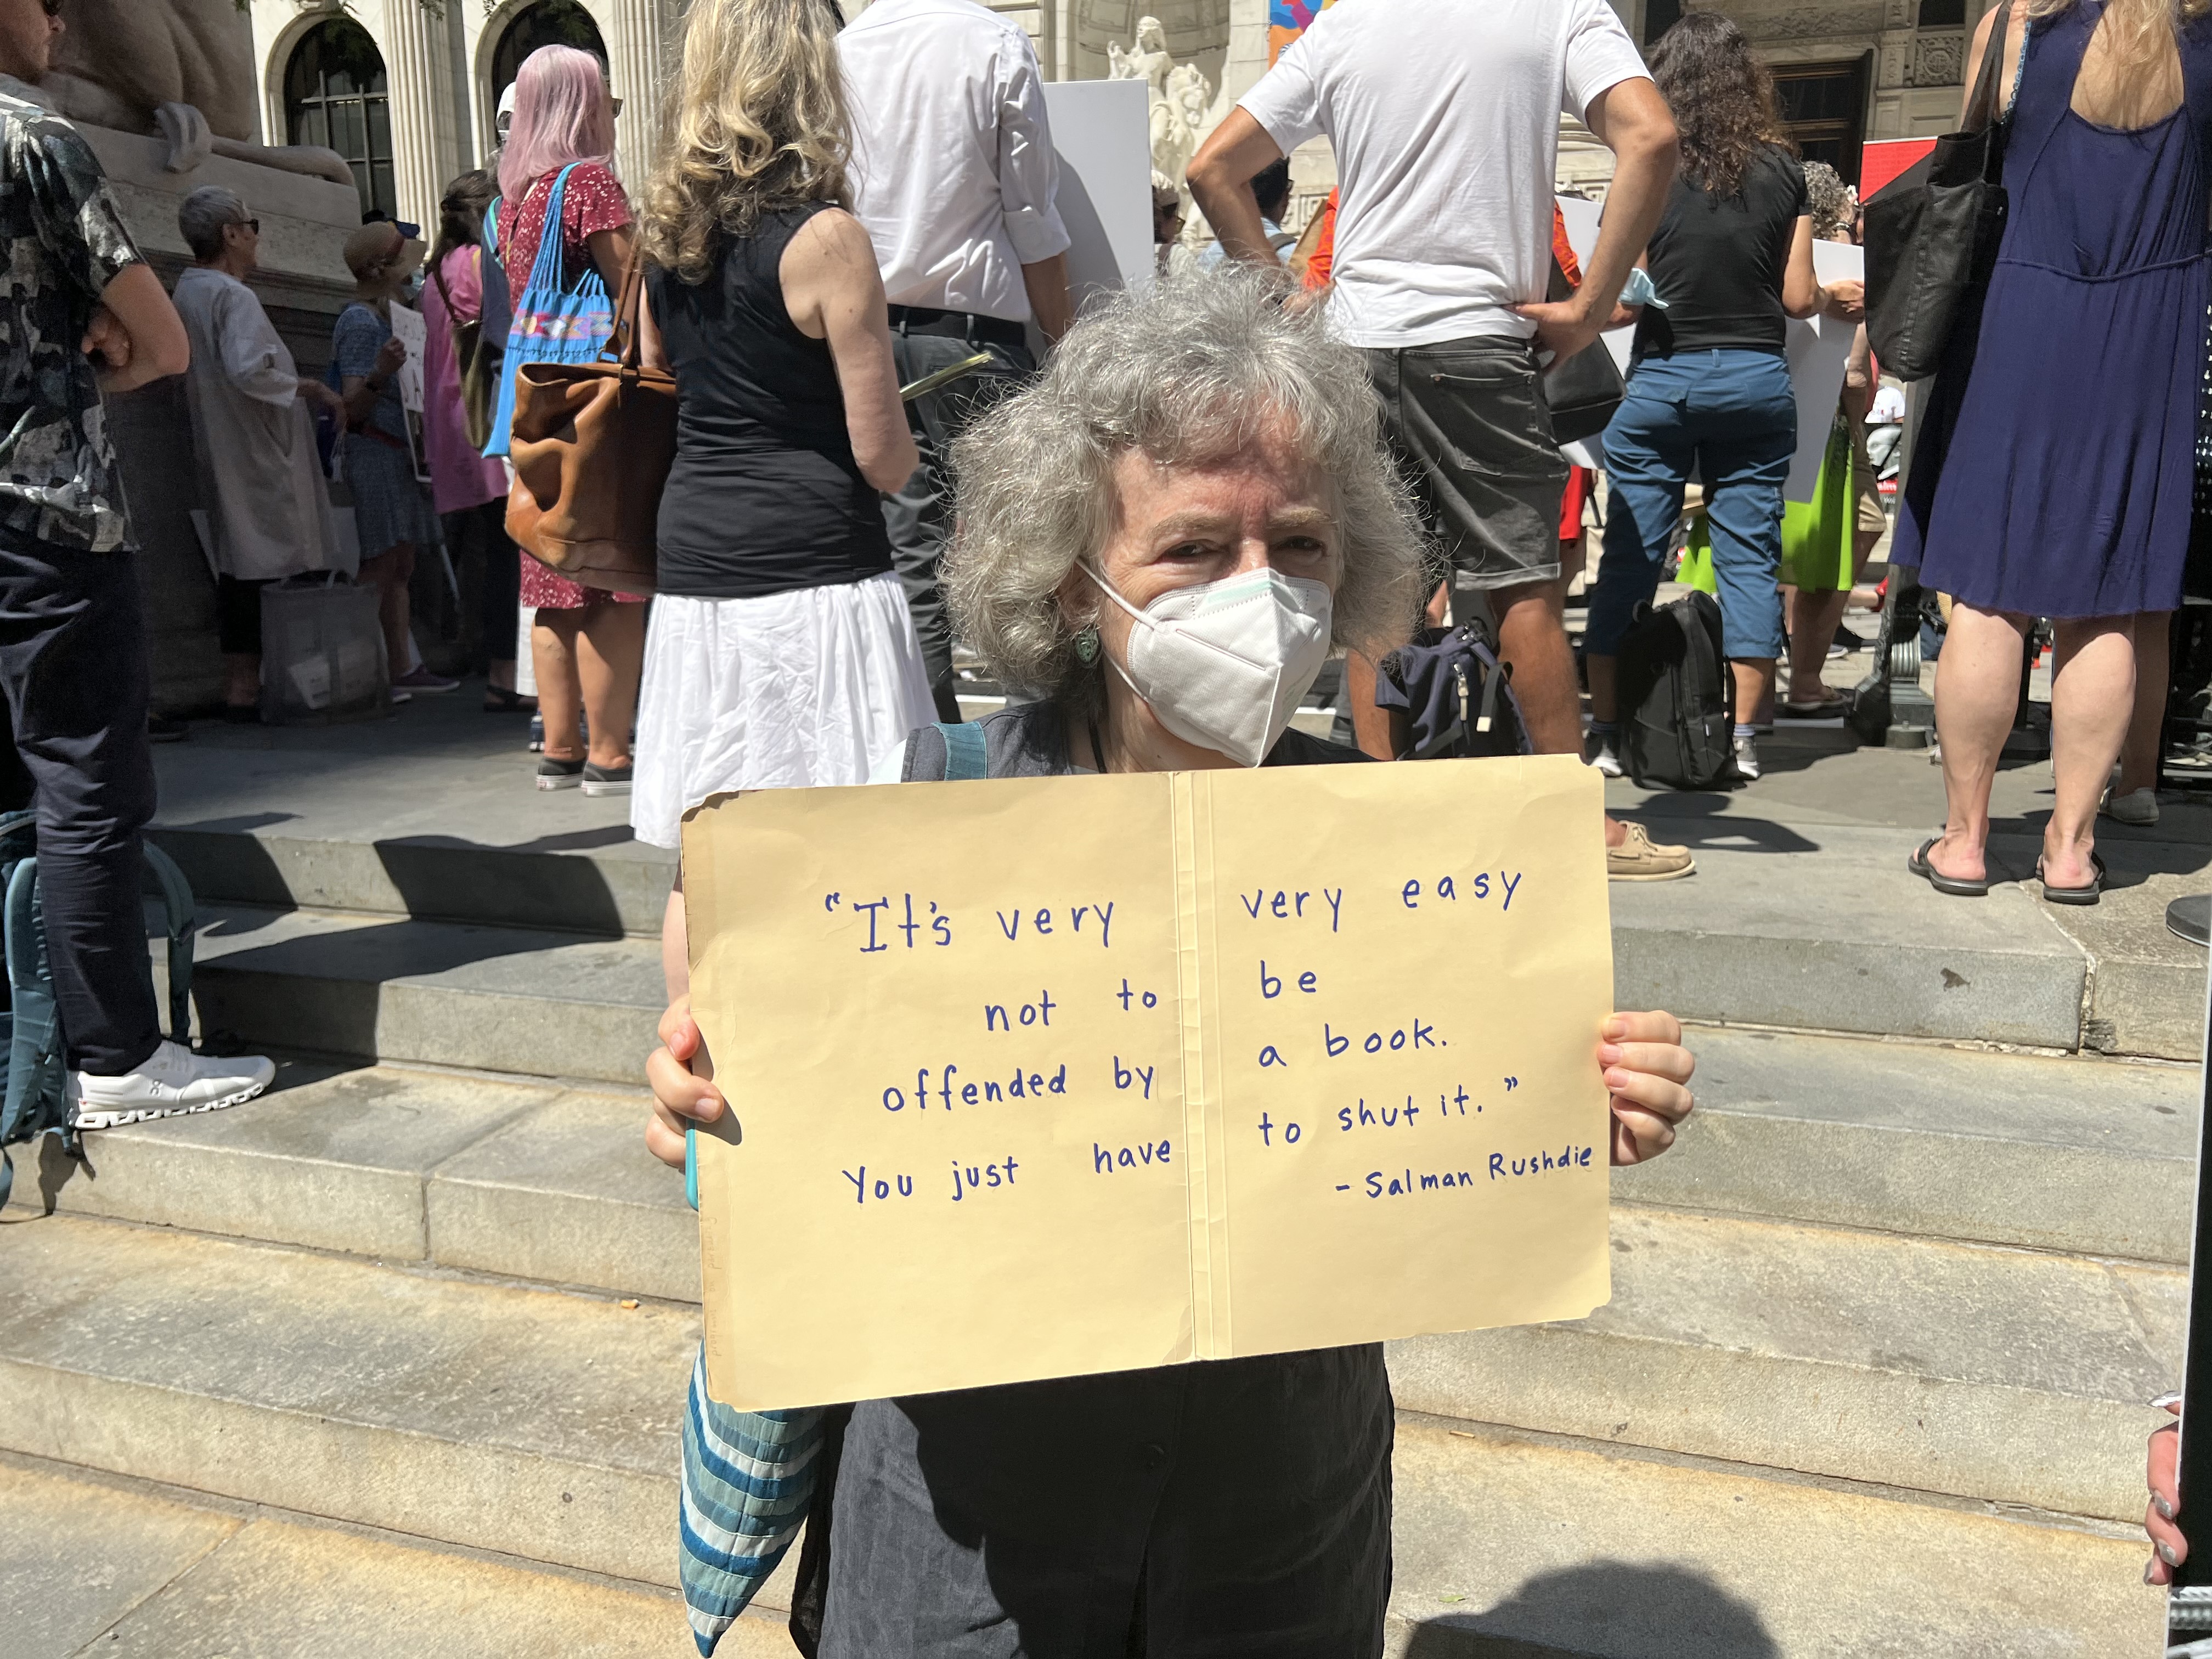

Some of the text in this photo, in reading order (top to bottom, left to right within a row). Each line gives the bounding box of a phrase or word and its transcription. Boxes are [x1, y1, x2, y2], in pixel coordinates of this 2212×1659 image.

[825, 871, 1521, 952] "It's very very easy
[985, 960, 1317, 1031] not to be
[882, 1018, 1447, 1111] offended by a book.
[842, 1165, 912, 1204] You
[952, 1155, 1019, 1201] just
[1093, 1140, 1170, 1173] have
[1258, 1111, 1301, 1146] to
[1338, 1095, 1419, 1131] shut
[1365, 1169, 1473, 1198] Salman
[1489, 1145, 1592, 1180] Rushdie
